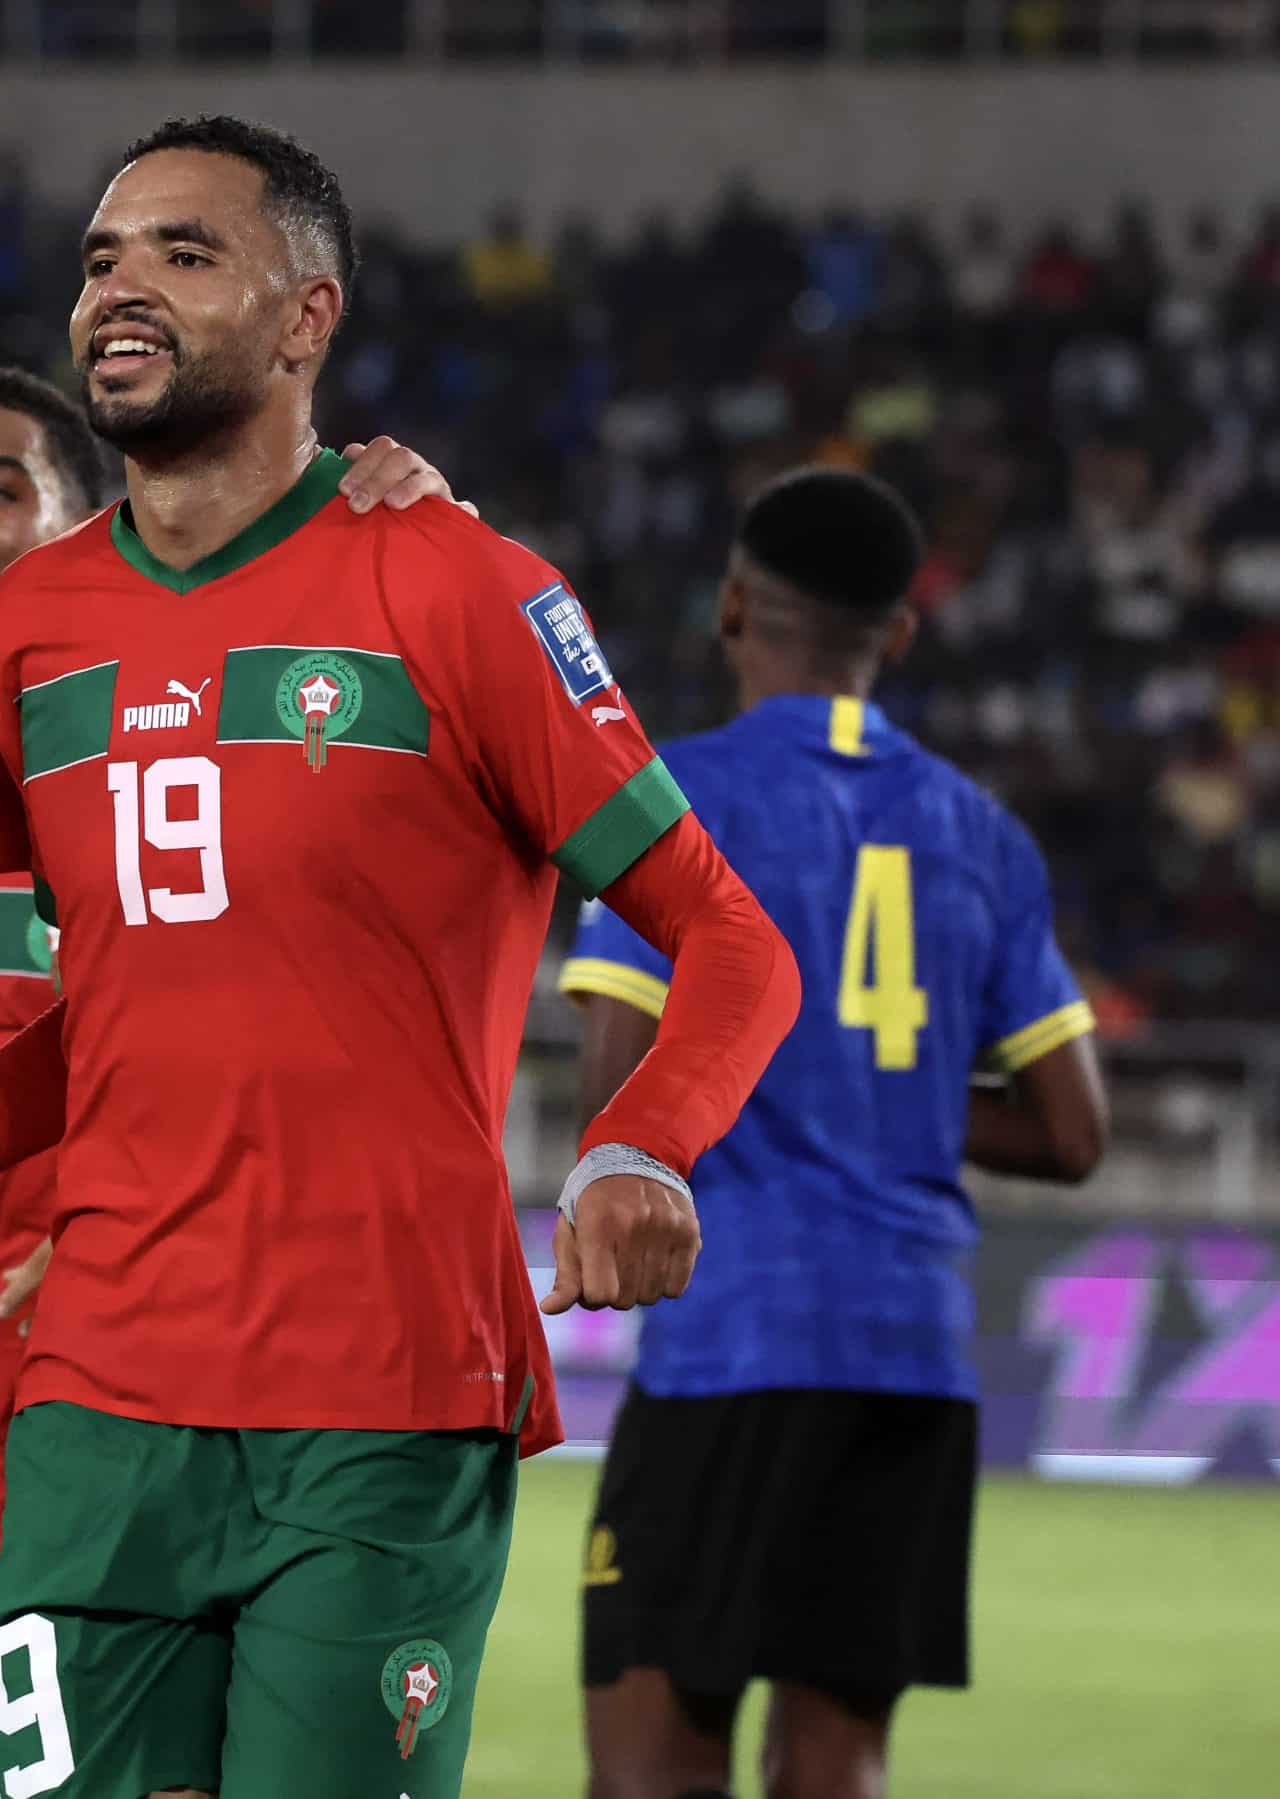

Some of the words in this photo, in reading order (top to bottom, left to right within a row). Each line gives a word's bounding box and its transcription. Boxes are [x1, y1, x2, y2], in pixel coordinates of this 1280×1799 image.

[123, 702, 190, 732] PUMA
[107, 756, 230, 926] 19
[837, 842, 928, 1068] 4
